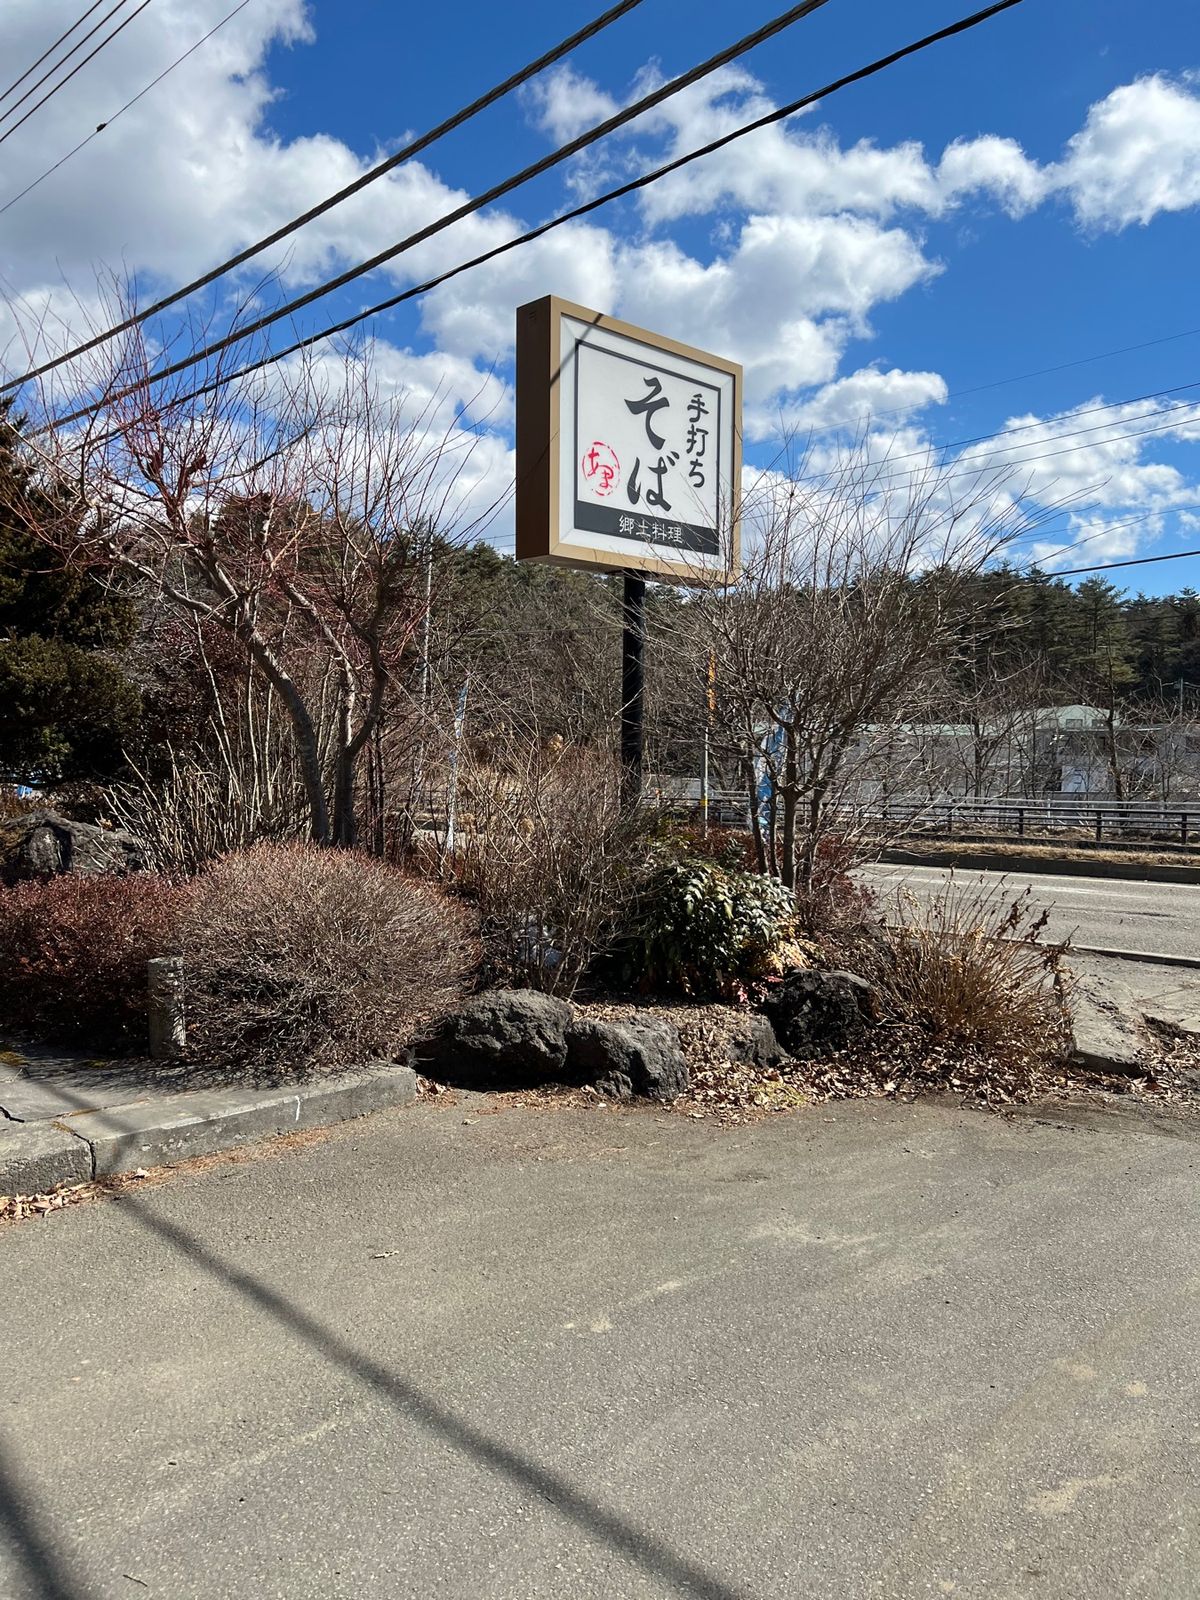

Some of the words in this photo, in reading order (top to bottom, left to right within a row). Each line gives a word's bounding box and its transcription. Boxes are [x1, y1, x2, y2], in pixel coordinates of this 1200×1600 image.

[624, 377, 680, 512] そば
[686, 393, 709, 488] 手打ち
[619, 514, 683, 544] 郷土料理
